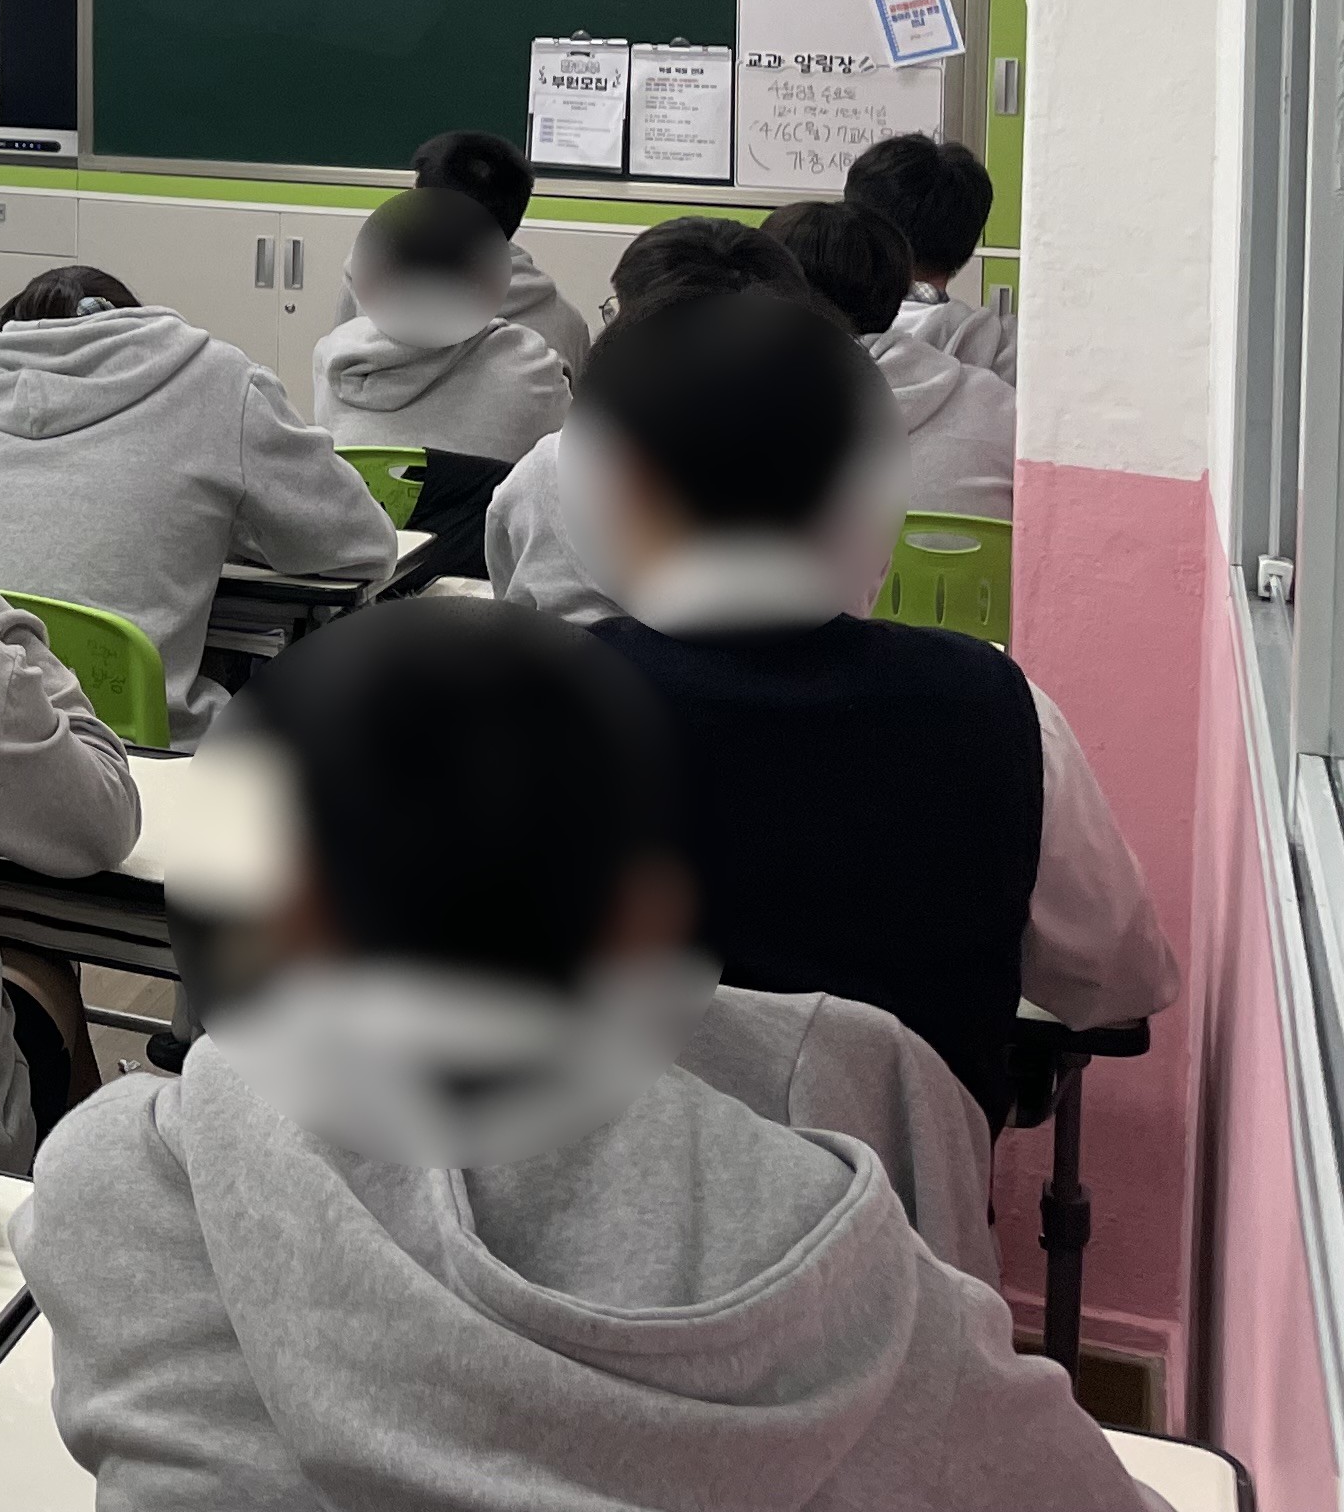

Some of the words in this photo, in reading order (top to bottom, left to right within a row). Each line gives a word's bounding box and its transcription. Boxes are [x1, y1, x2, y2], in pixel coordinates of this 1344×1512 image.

[746, 53, 784, 68] 교과
[794, 54, 855, 74] 알림장
[552, 75, 608, 92] 부원모집
[837, 125, 875, 145] 7교시
